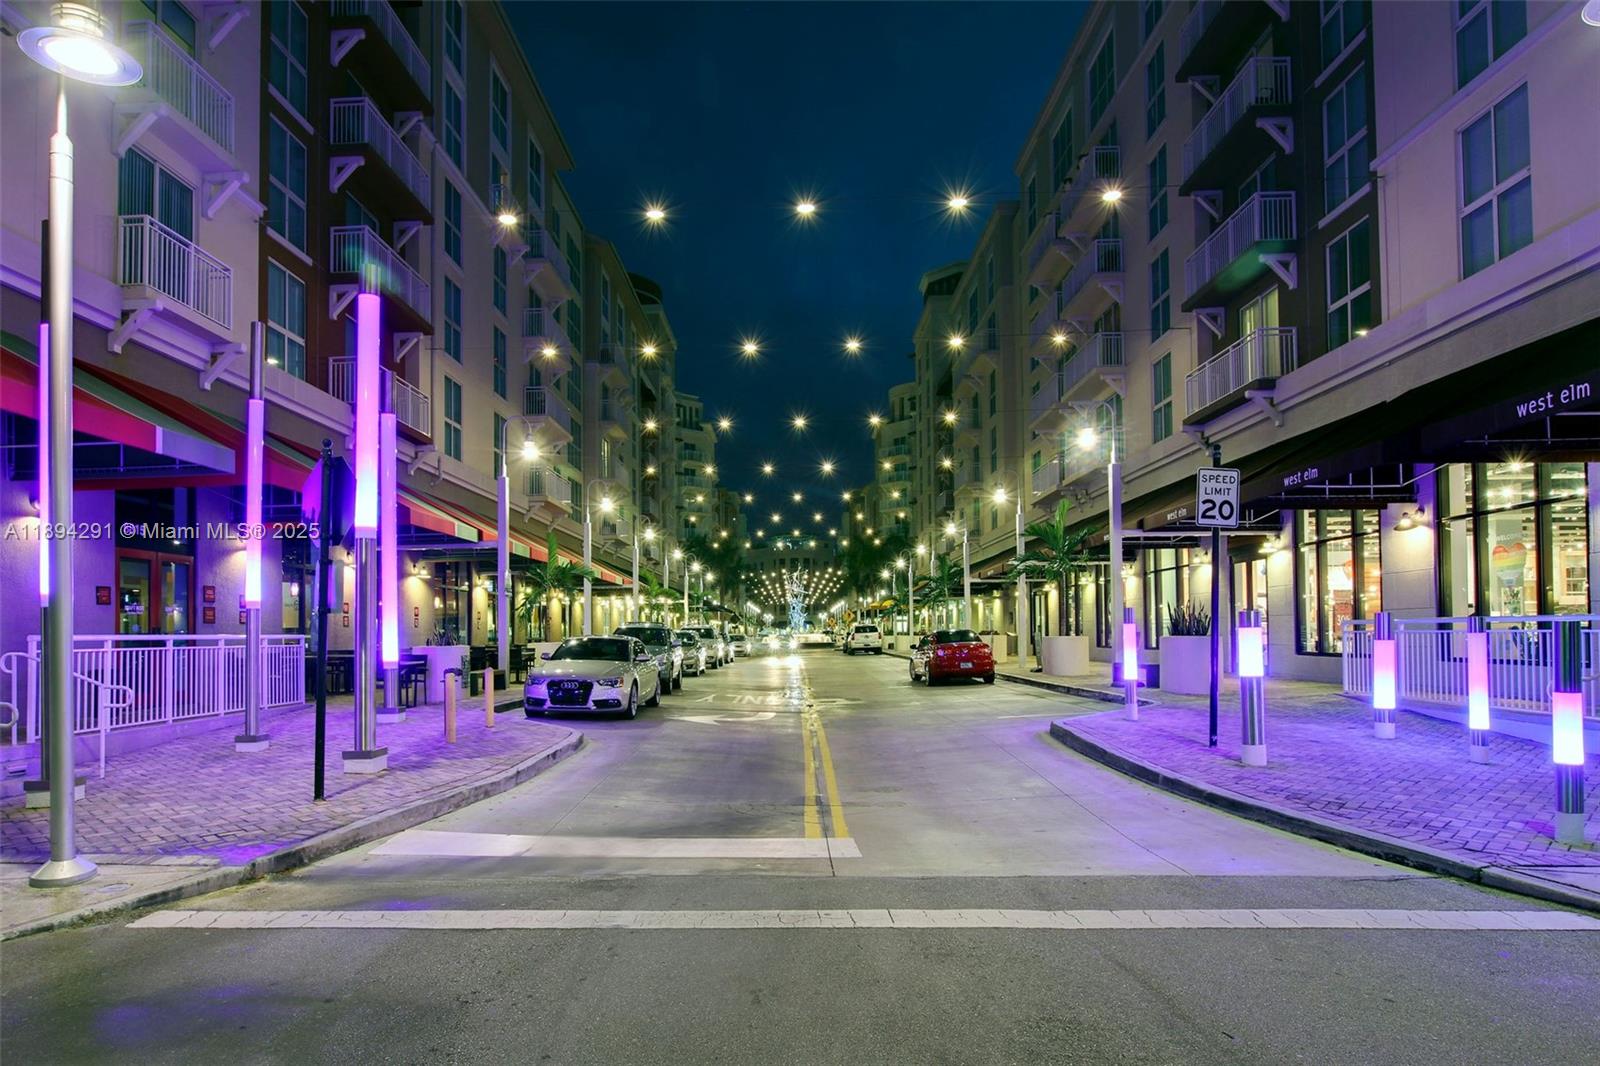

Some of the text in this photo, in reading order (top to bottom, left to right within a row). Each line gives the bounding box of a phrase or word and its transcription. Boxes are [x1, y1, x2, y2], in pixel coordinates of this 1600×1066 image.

[1517, 382, 1591, 418] west elm
[1201, 474, 1236, 484] SPEED
[1283, 468, 1318, 487] west elm
[1204, 487, 1231, 496] LIMIT
[1201, 499, 1234, 520] 20
